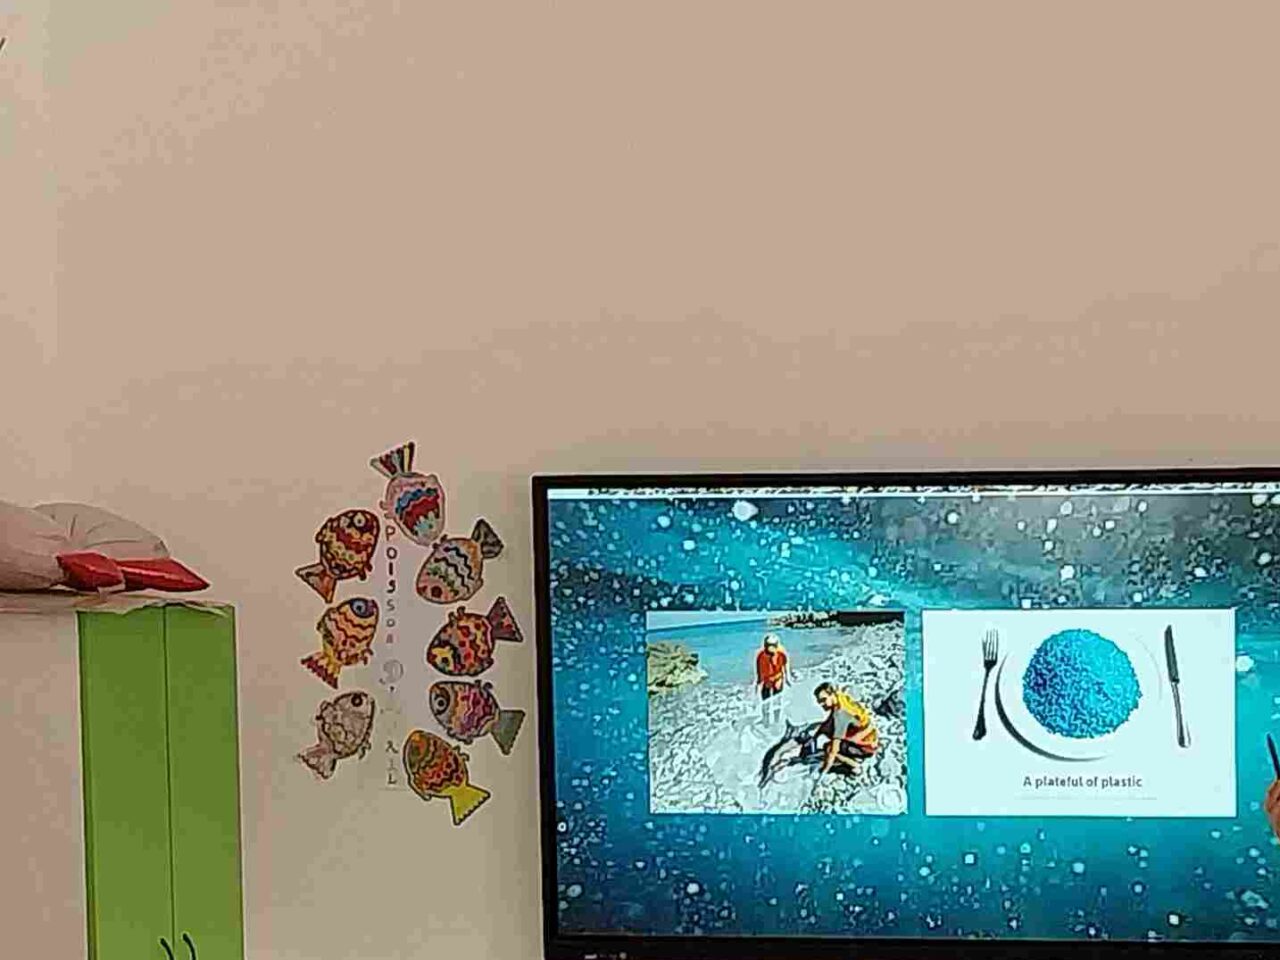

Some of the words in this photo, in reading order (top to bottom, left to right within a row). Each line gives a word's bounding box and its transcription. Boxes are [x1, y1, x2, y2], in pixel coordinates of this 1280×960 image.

[1023, 777, 1032, 787] A
[1035, 776, 1083, 789] plateful
[1085, 776, 1098, 787] of
[1101, 776, 1143, 789] plastic
